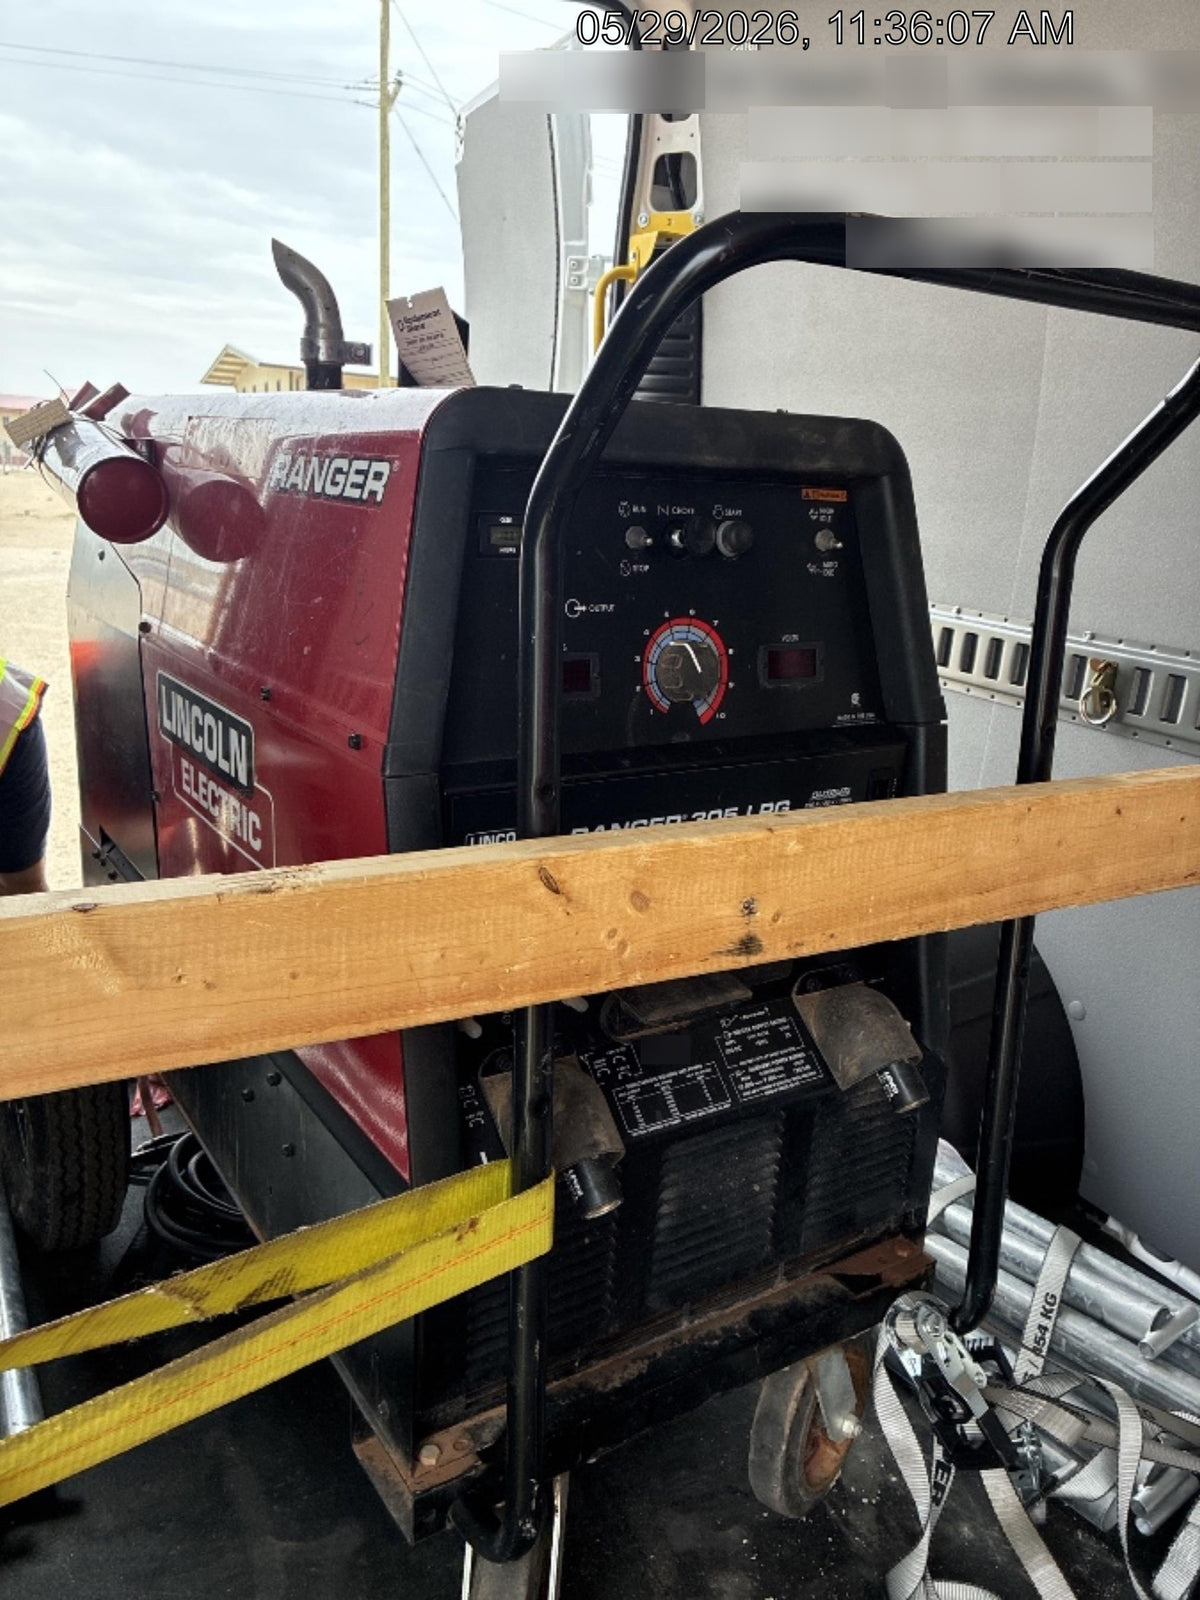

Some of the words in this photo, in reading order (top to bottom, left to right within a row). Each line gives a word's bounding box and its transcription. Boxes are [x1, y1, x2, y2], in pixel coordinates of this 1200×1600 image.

[269, 452, 390, 503] RANGER
[161, 684, 249, 787] LINCOLN
[180, 757, 263, 853] ELECTRIC
[469, 831, 517, 847] LINCO
[1040, 1291, 1057, 1320] KG
